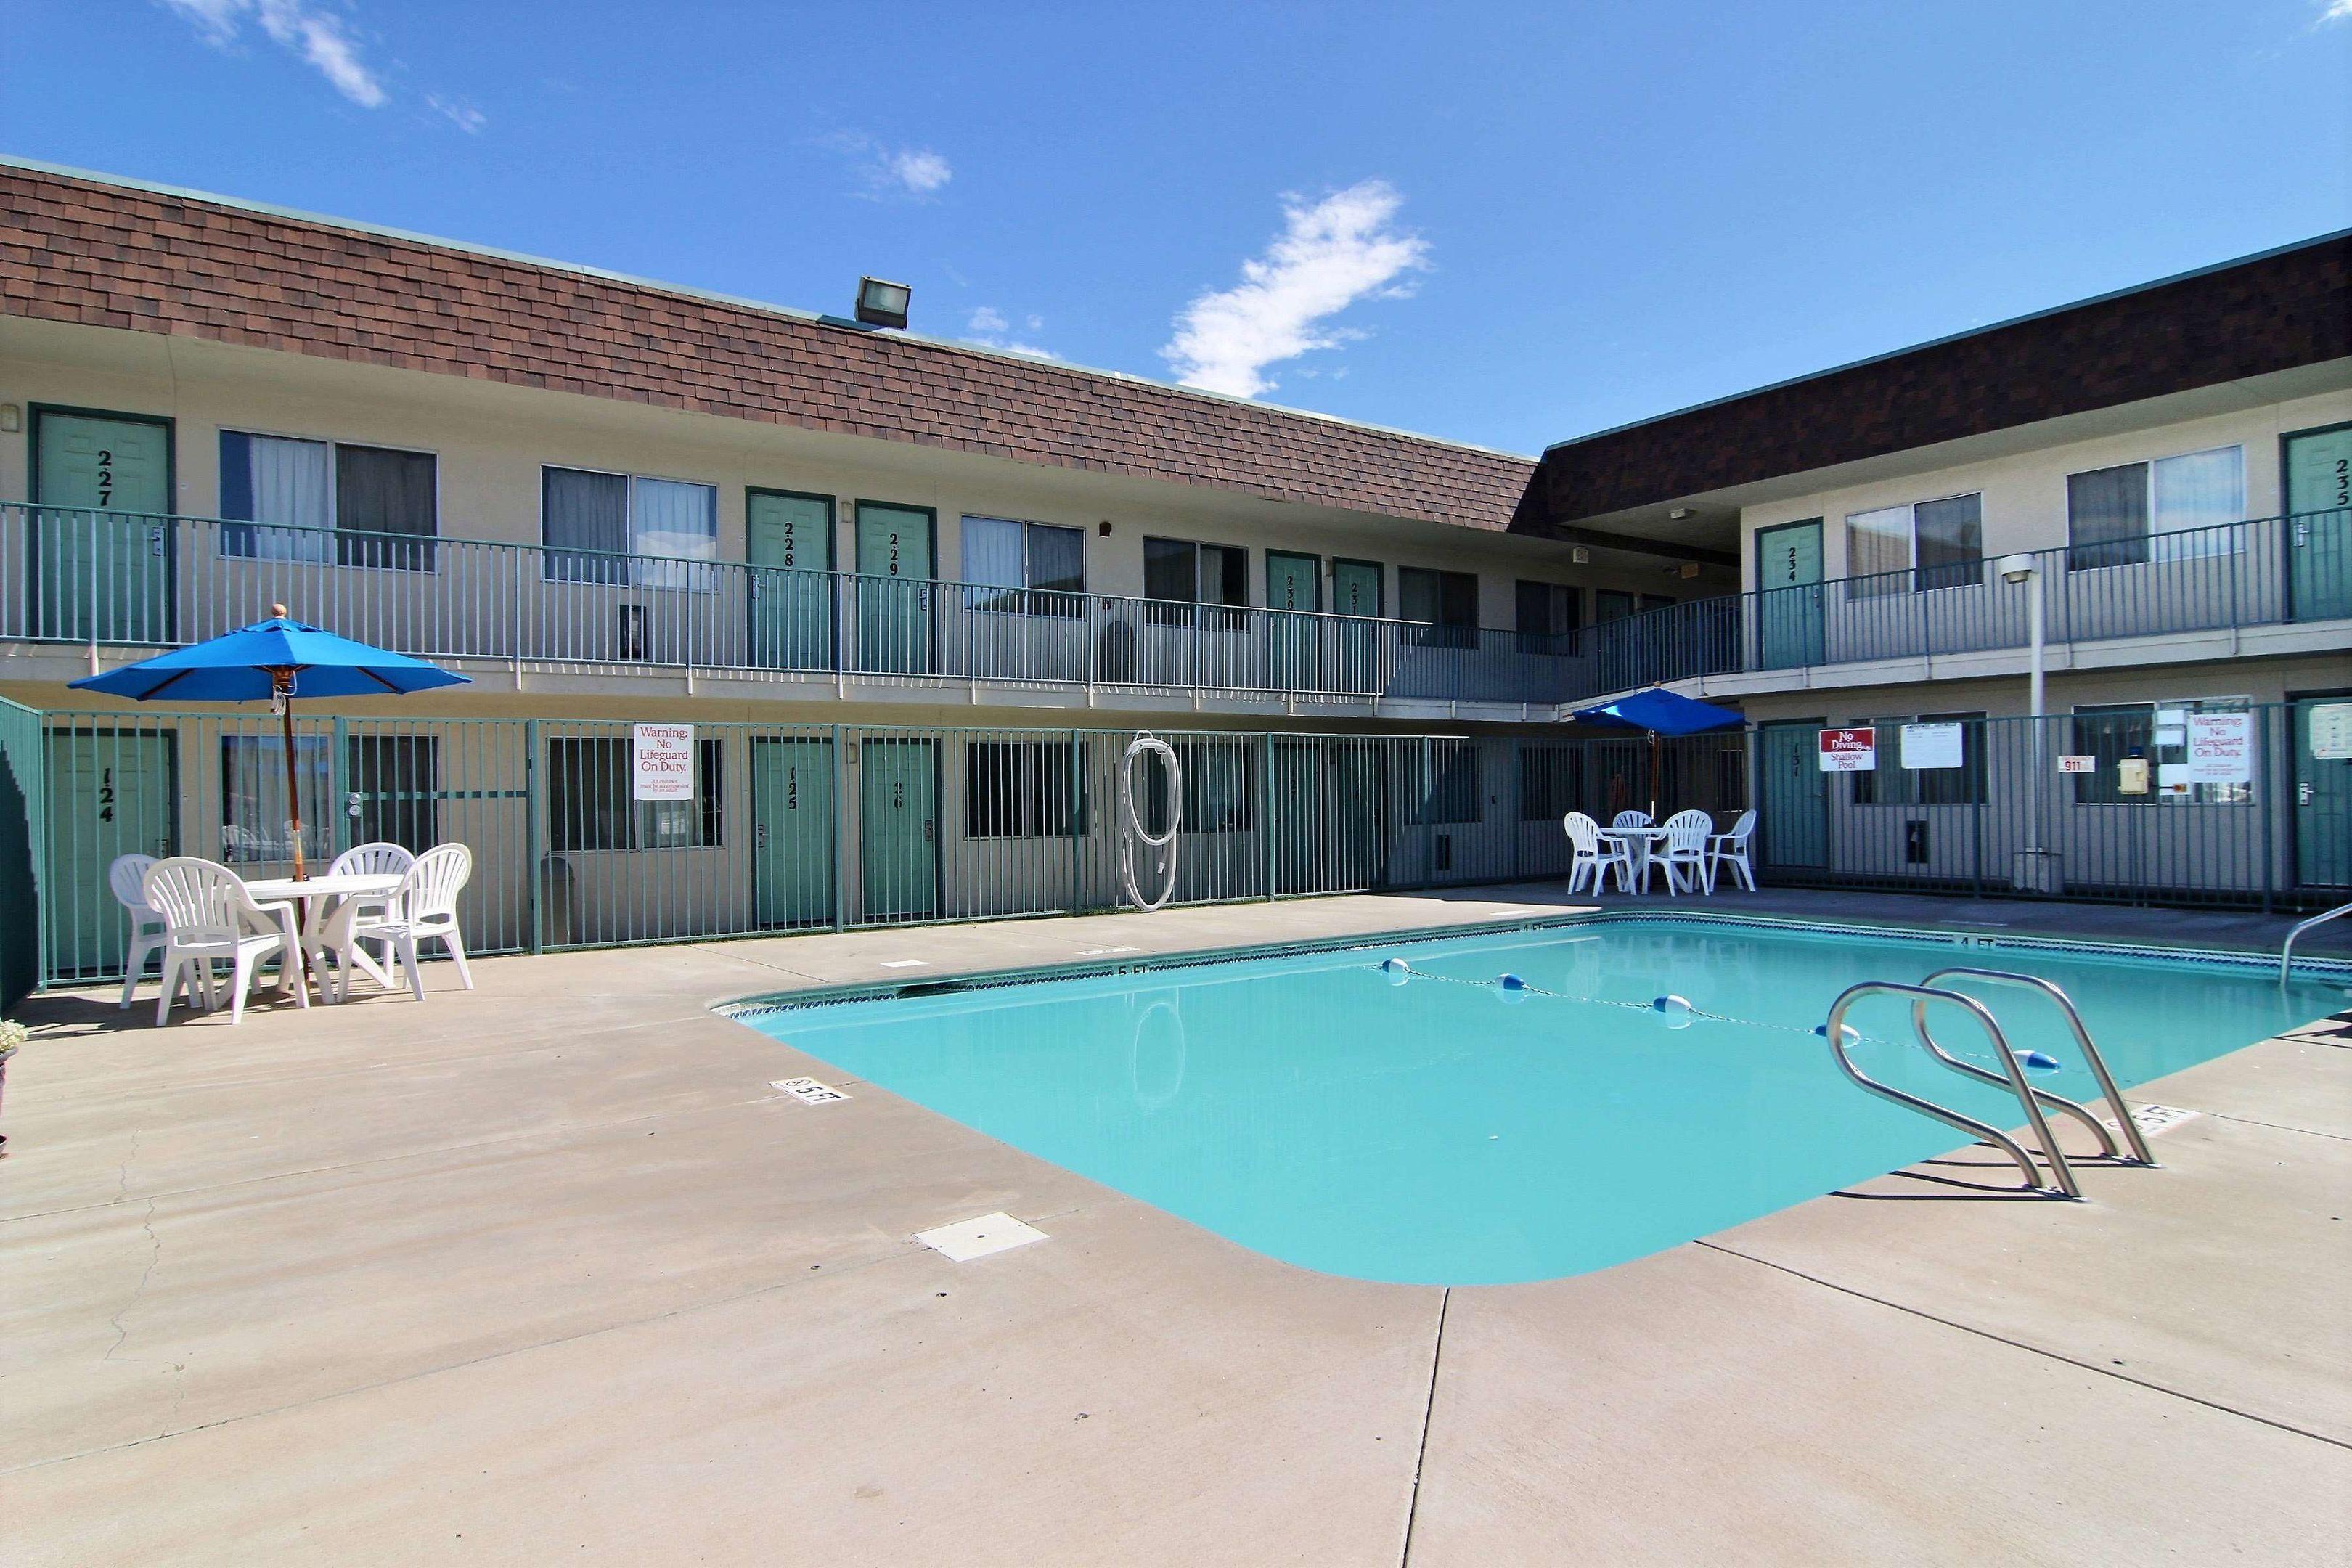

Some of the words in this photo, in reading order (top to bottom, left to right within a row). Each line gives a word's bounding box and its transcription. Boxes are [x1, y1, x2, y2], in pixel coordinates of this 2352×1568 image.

[98, 450, 112, 506] 227
[2337, 459, 2349, 505] 235
[785, 522, 793, 566] 228
[889, 533, 898, 576] 229
[640, 727, 688, 740] Warning:
[1839, 731, 1853, 740] No
[2210, 727, 2226, 736] No
[656, 739, 672, 749] No
[1832, 740, 1862, 751] Diving
[640, 749, 688, 761] Lifeguard
[1831, 753, 1863, 761] Shallow
[641, 761, 658, 772] On
[661, 761, 687, 774] Duty.
[2065, 761, 2081, 771] 911
[99, 768, 113, 822] 124
